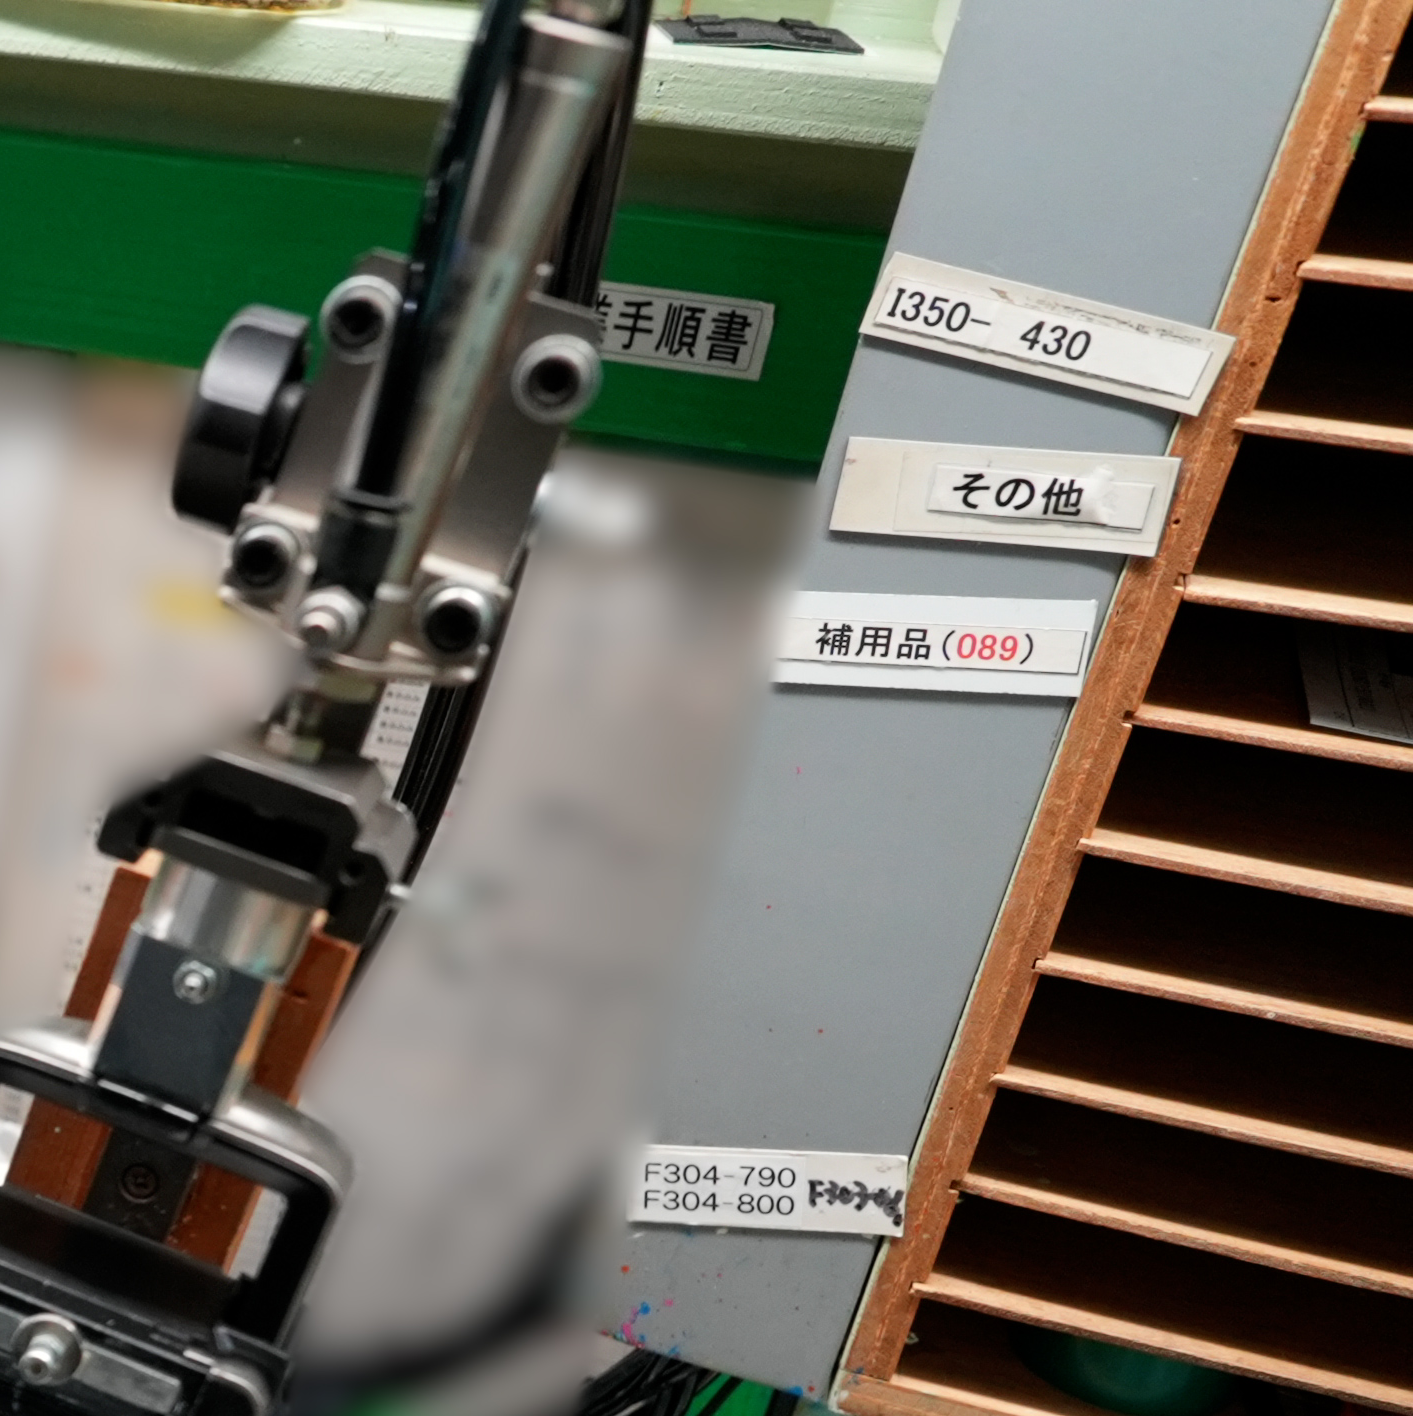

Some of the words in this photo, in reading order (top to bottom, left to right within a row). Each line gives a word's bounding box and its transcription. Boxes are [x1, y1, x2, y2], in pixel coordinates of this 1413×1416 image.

[1019, 320, 1092, 361] 430
[953, 472, 1083, 517] その他
[644, 1163, 797, 1188] F304-790
[644, 1190, 795, 1216] F304-800
